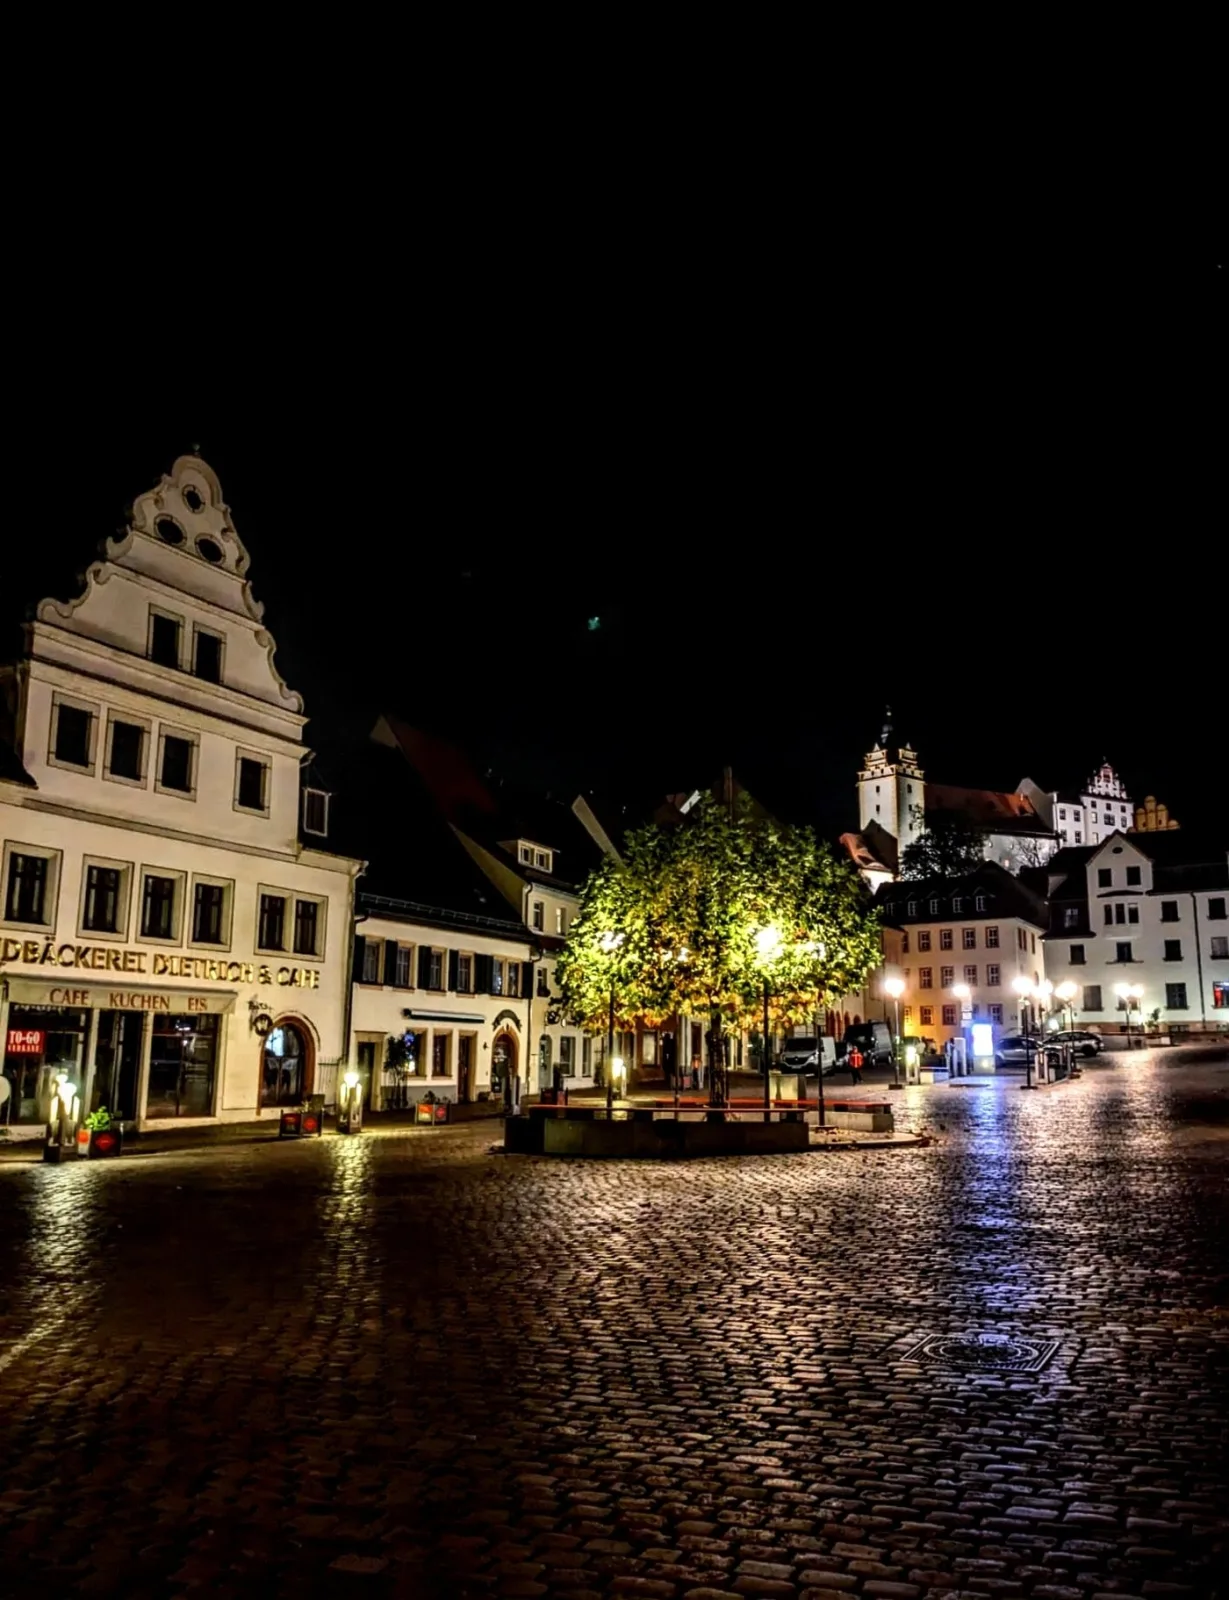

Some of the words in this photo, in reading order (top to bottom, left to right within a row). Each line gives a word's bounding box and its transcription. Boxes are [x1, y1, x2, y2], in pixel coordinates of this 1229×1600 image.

[0, 936, 147, 974] DBÄCKEREI
[153, 953, 253, 983] DIETRICH
[259, 965, 272, 985] &
[109, 992, 170, 1010] KUCHEN
[187, 997, 208, 1011] EIS
[9, 1030, 40, 1044] TO-GO
